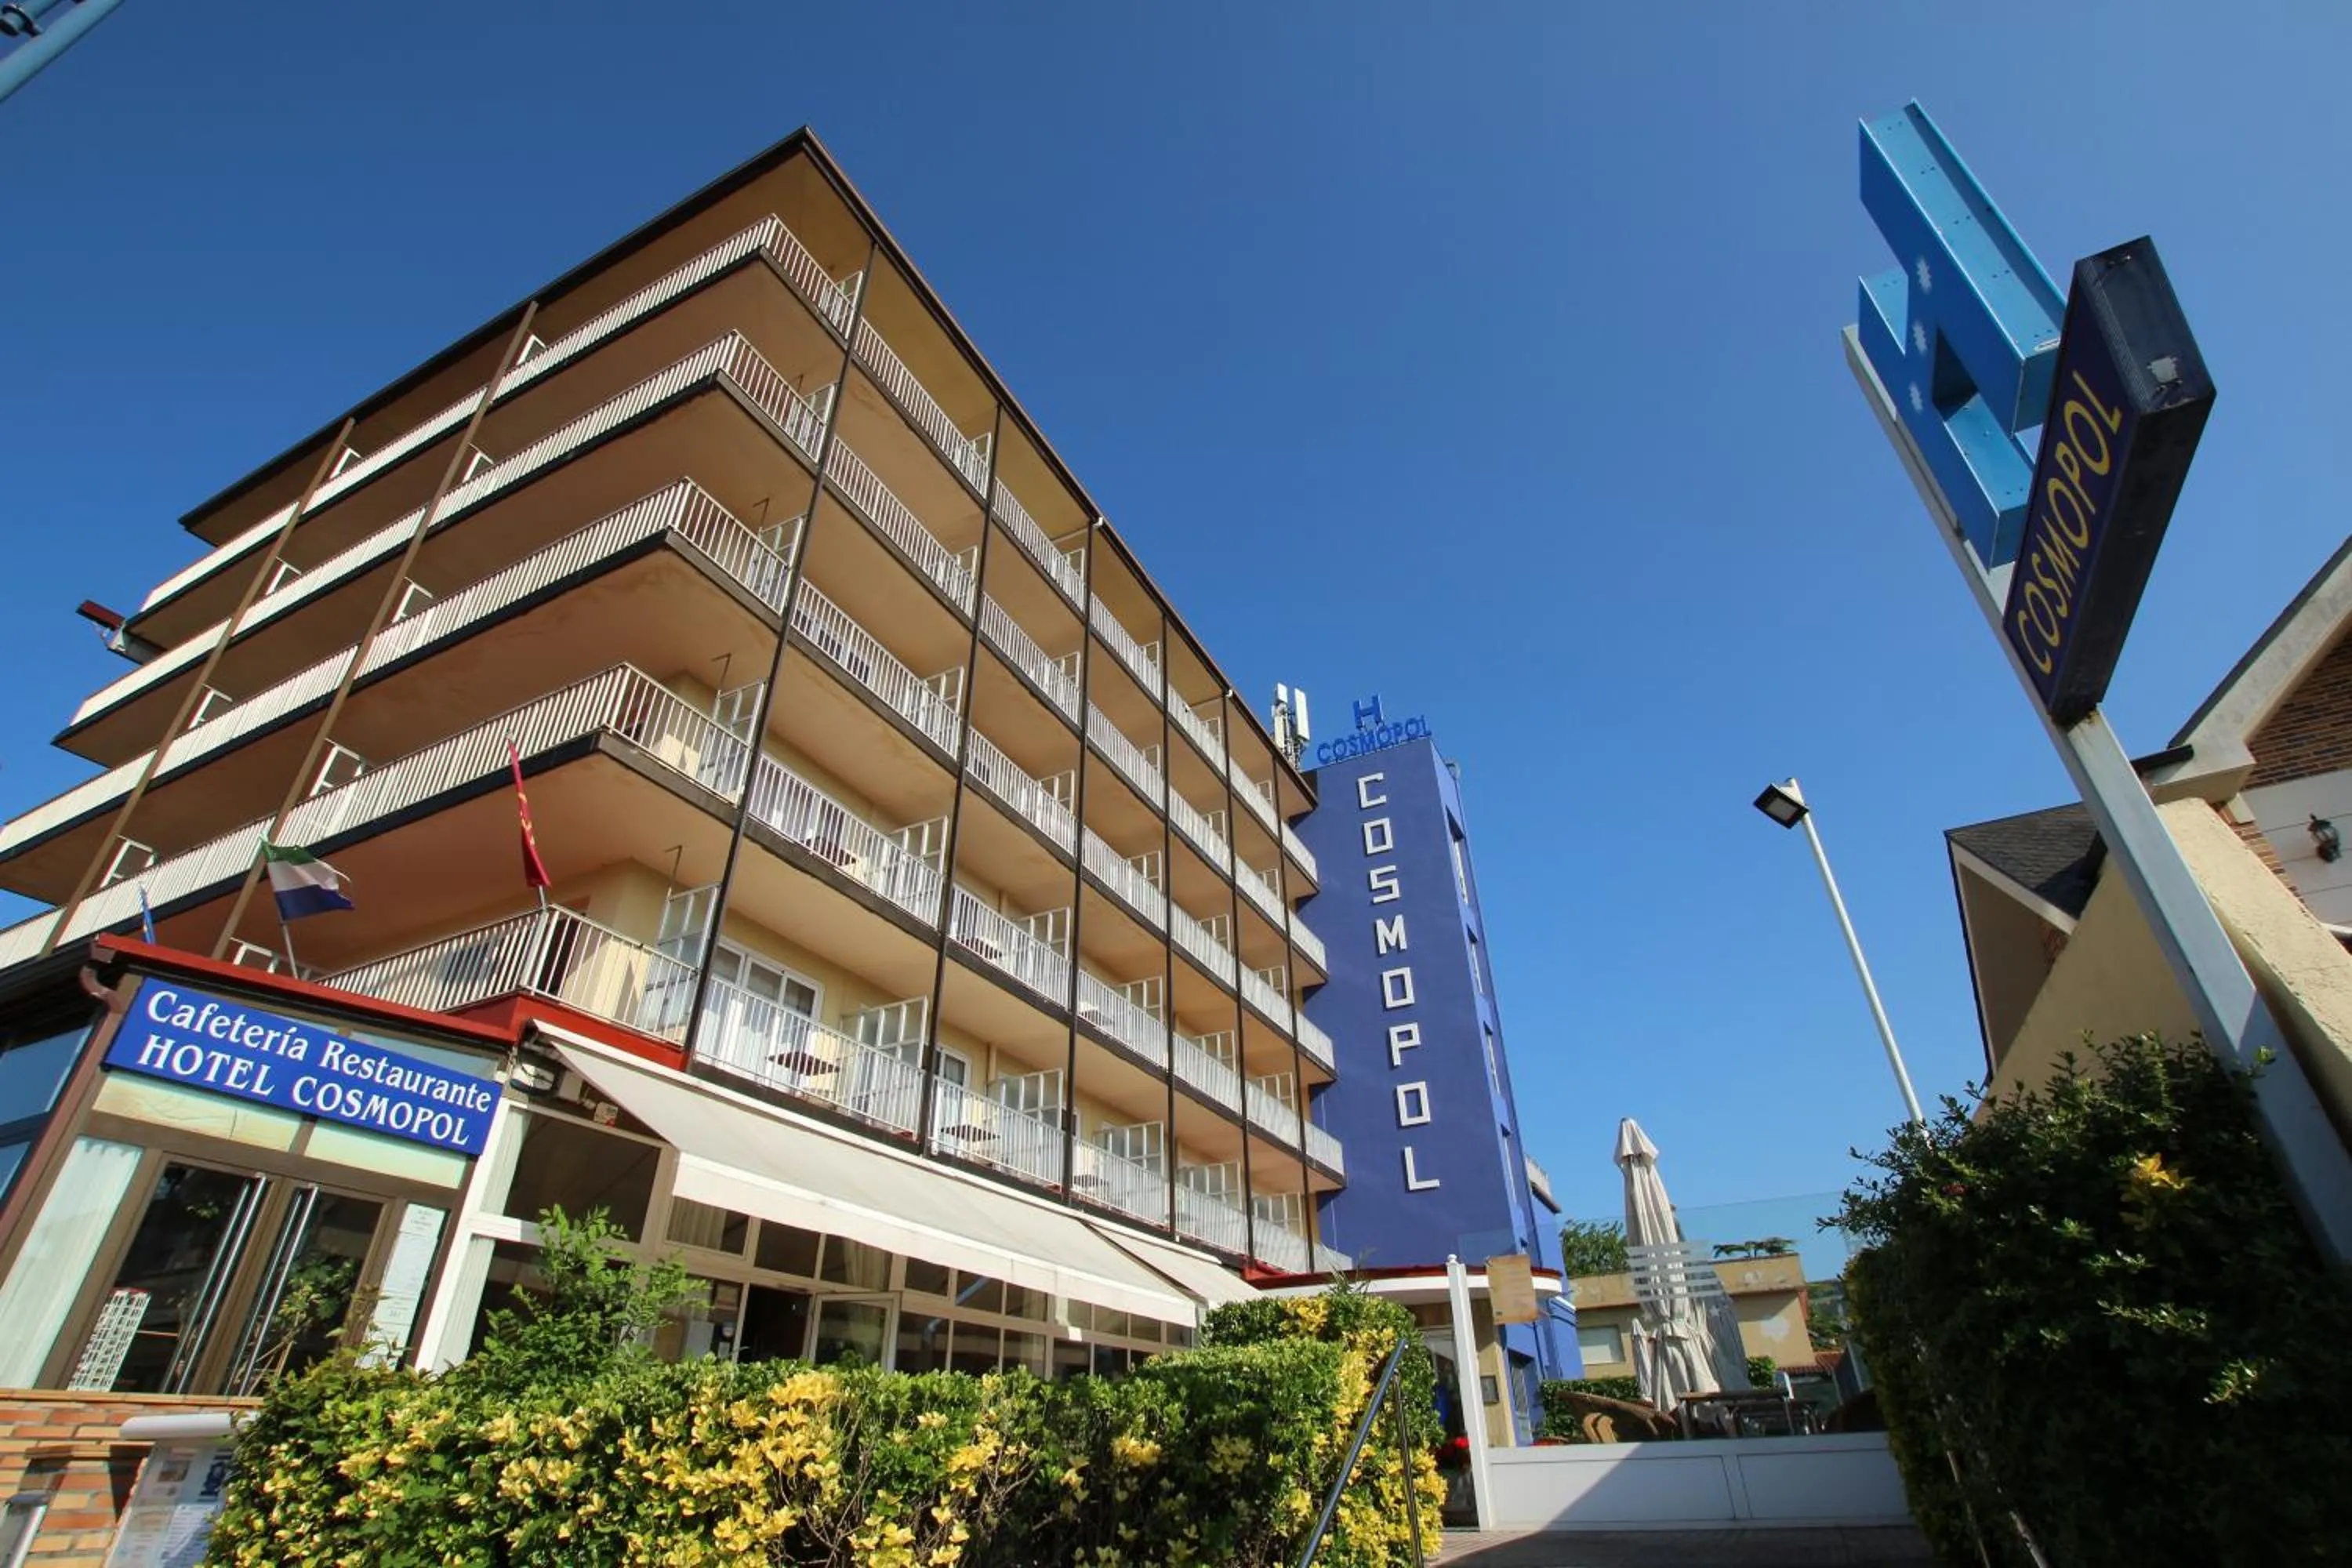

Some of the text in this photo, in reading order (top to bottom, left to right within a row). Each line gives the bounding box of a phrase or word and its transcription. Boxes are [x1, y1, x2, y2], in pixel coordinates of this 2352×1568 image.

[2018, 370, 2122, 675] COSMOPOL
[1317, 714, 1432, 764] COSMOPOL
[1352, 693, 1384, 729] H
[1357, 771, 1440, 1192] COSMOPOL
[138, 1035, 470, 1146] HOTEL COSMOPOL
[148, 990, 492, 1113] Cafetería Restaurante
